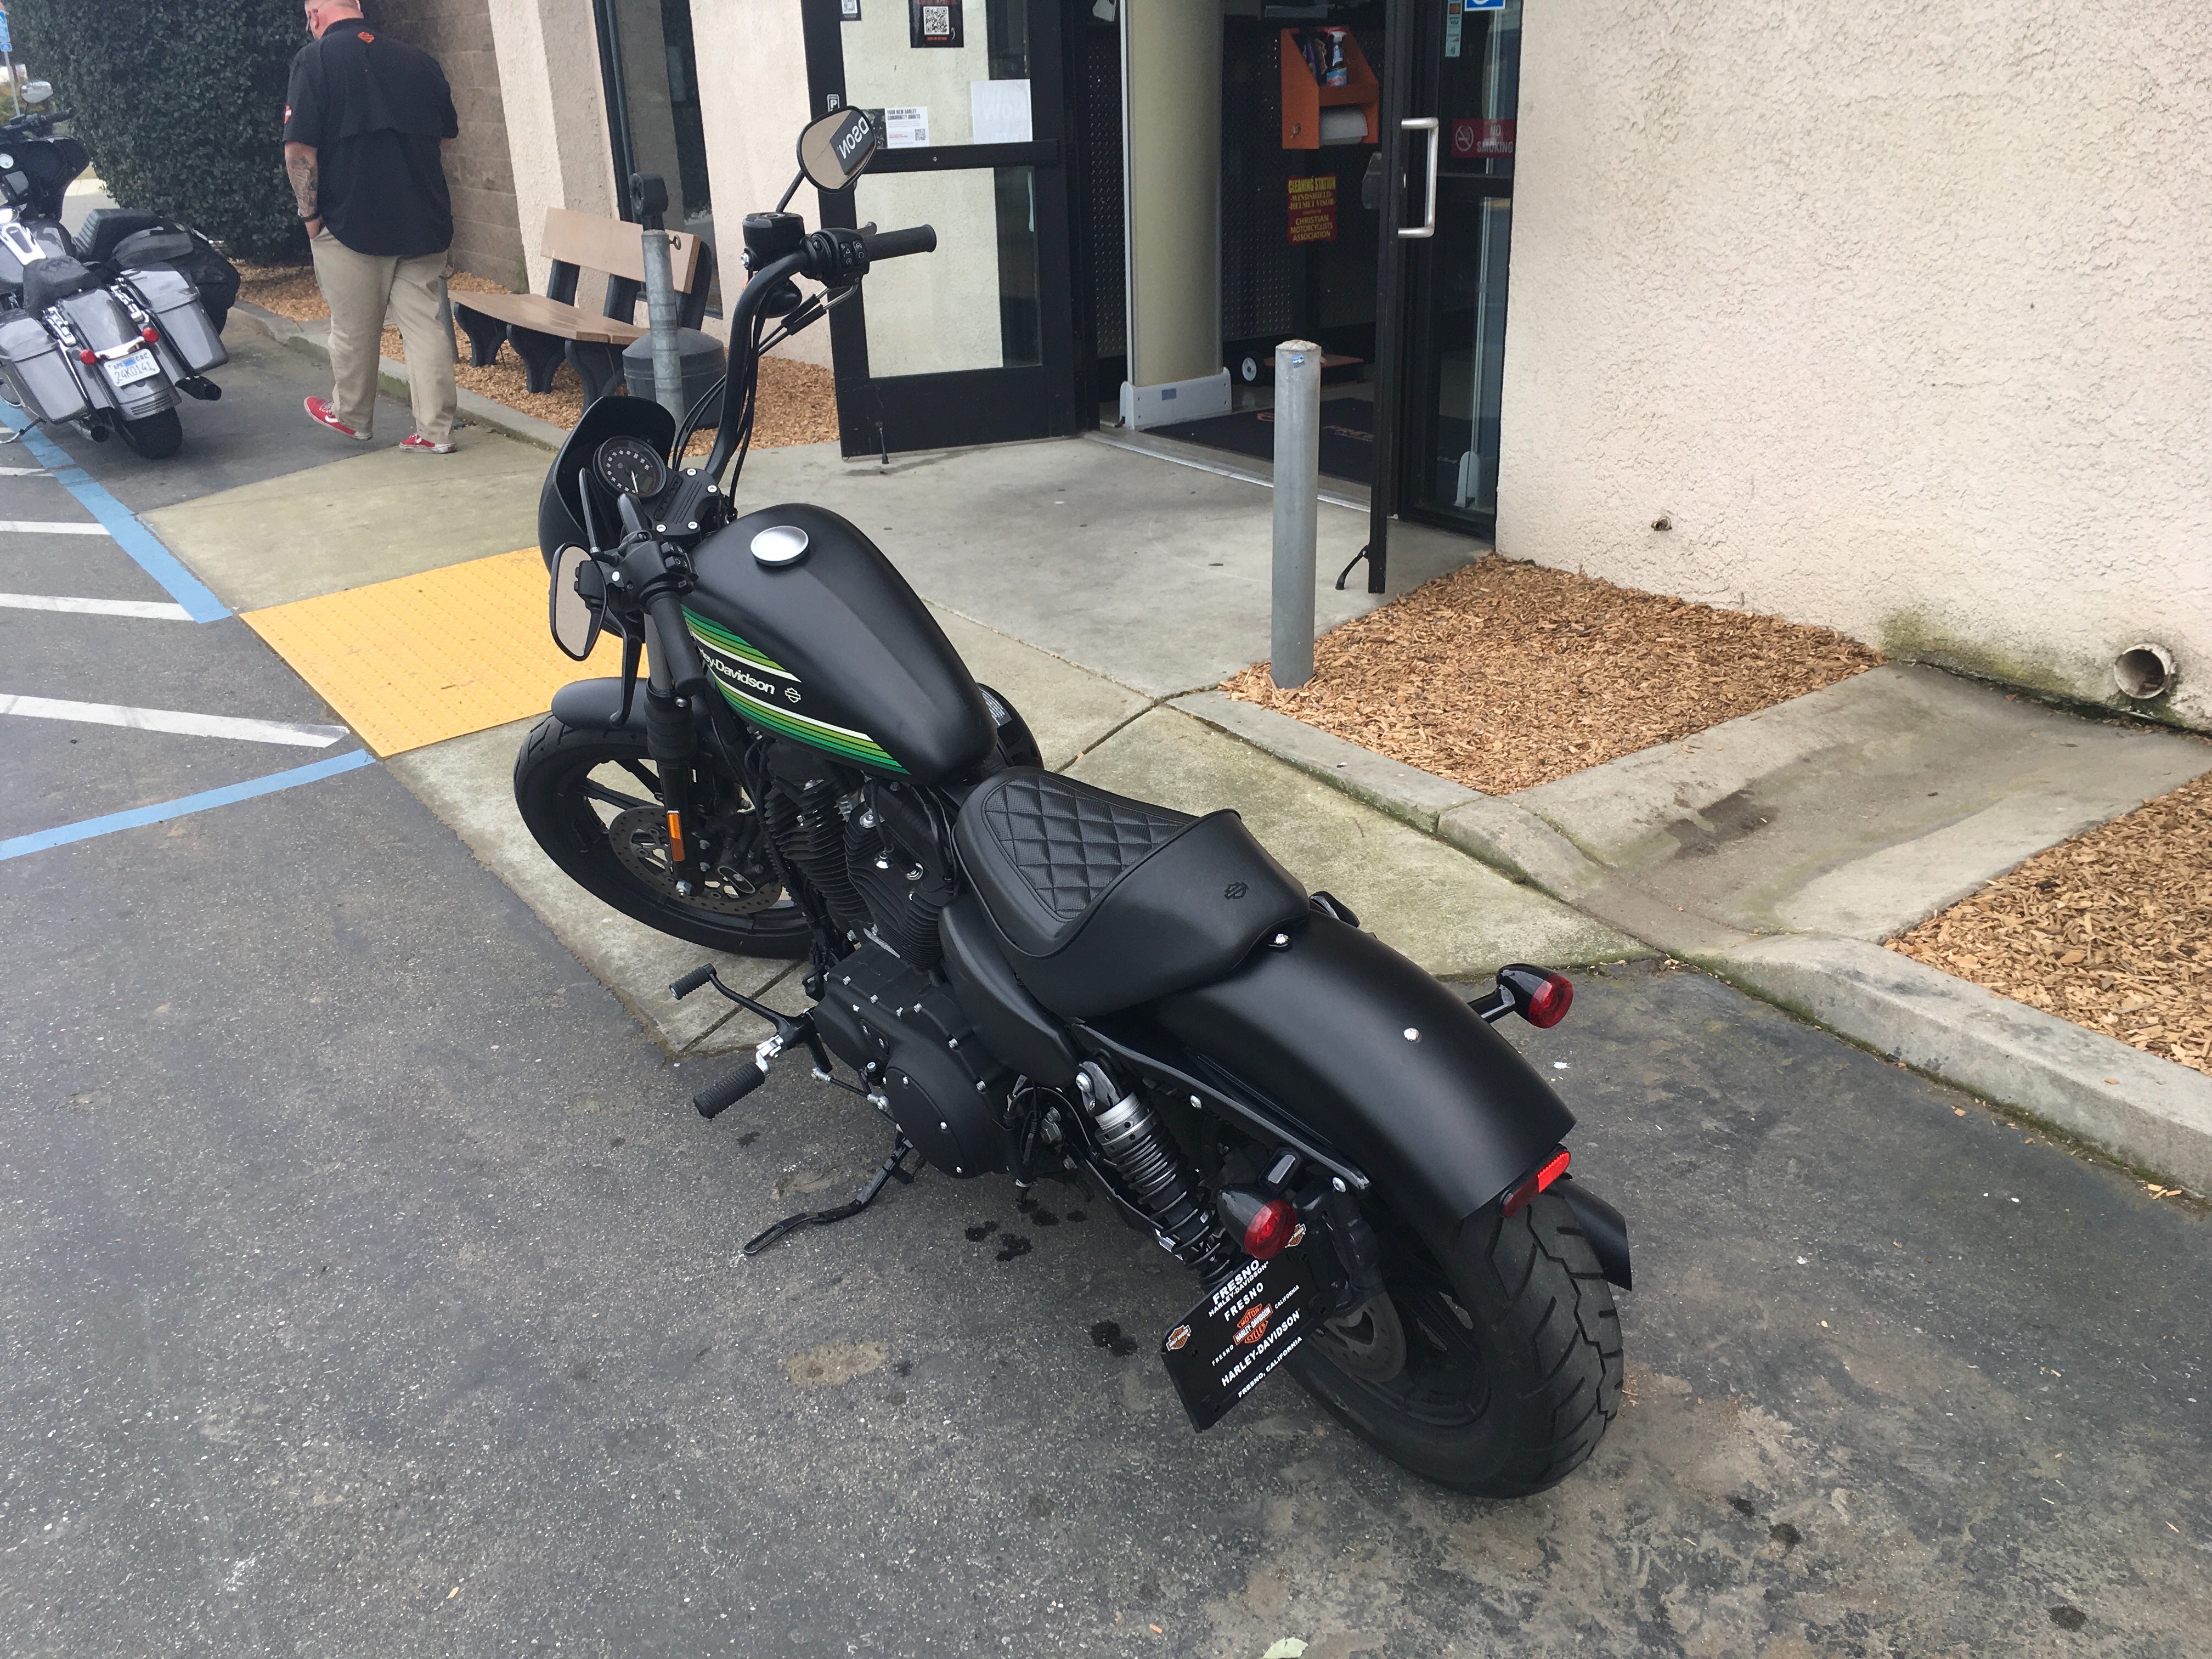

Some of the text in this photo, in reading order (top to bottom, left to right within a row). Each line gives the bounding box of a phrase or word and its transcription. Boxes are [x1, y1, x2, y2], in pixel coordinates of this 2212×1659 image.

[1490, 125, 1501, 136] NO
[1477, 141, 1514, 153] SMOKING
[1288, 176, 1336, 194] CLEANING STATION
[1290, 222, 1333, 234] MOTORCYCLISTS
[1295, 214, 1329, 225] CHRISTIAN
[1293, 230, 1331, 241] ASSOCIATION
[701, 649, 775, 695] ley-Davidson
[1212, 1260, 1259, 1305] FRESNO
[1224, 1282, 1263, 1322] FRESNO
[1211, 1284, 1300, 1367] FRESNO CALIFORNIA
[1235, 1306, 1271, 1342] HARLEY-DAVIDSON
[1241, 1307, 1260, 1327] MOTOR
[1246, 1322, 1266, 1341] CYCLES
[1221, 1310, 1300, 1387] HARLEY-DAVIDSON
[1238, 1336, 1302, 1398] FRESNO, CALIFORNIA
